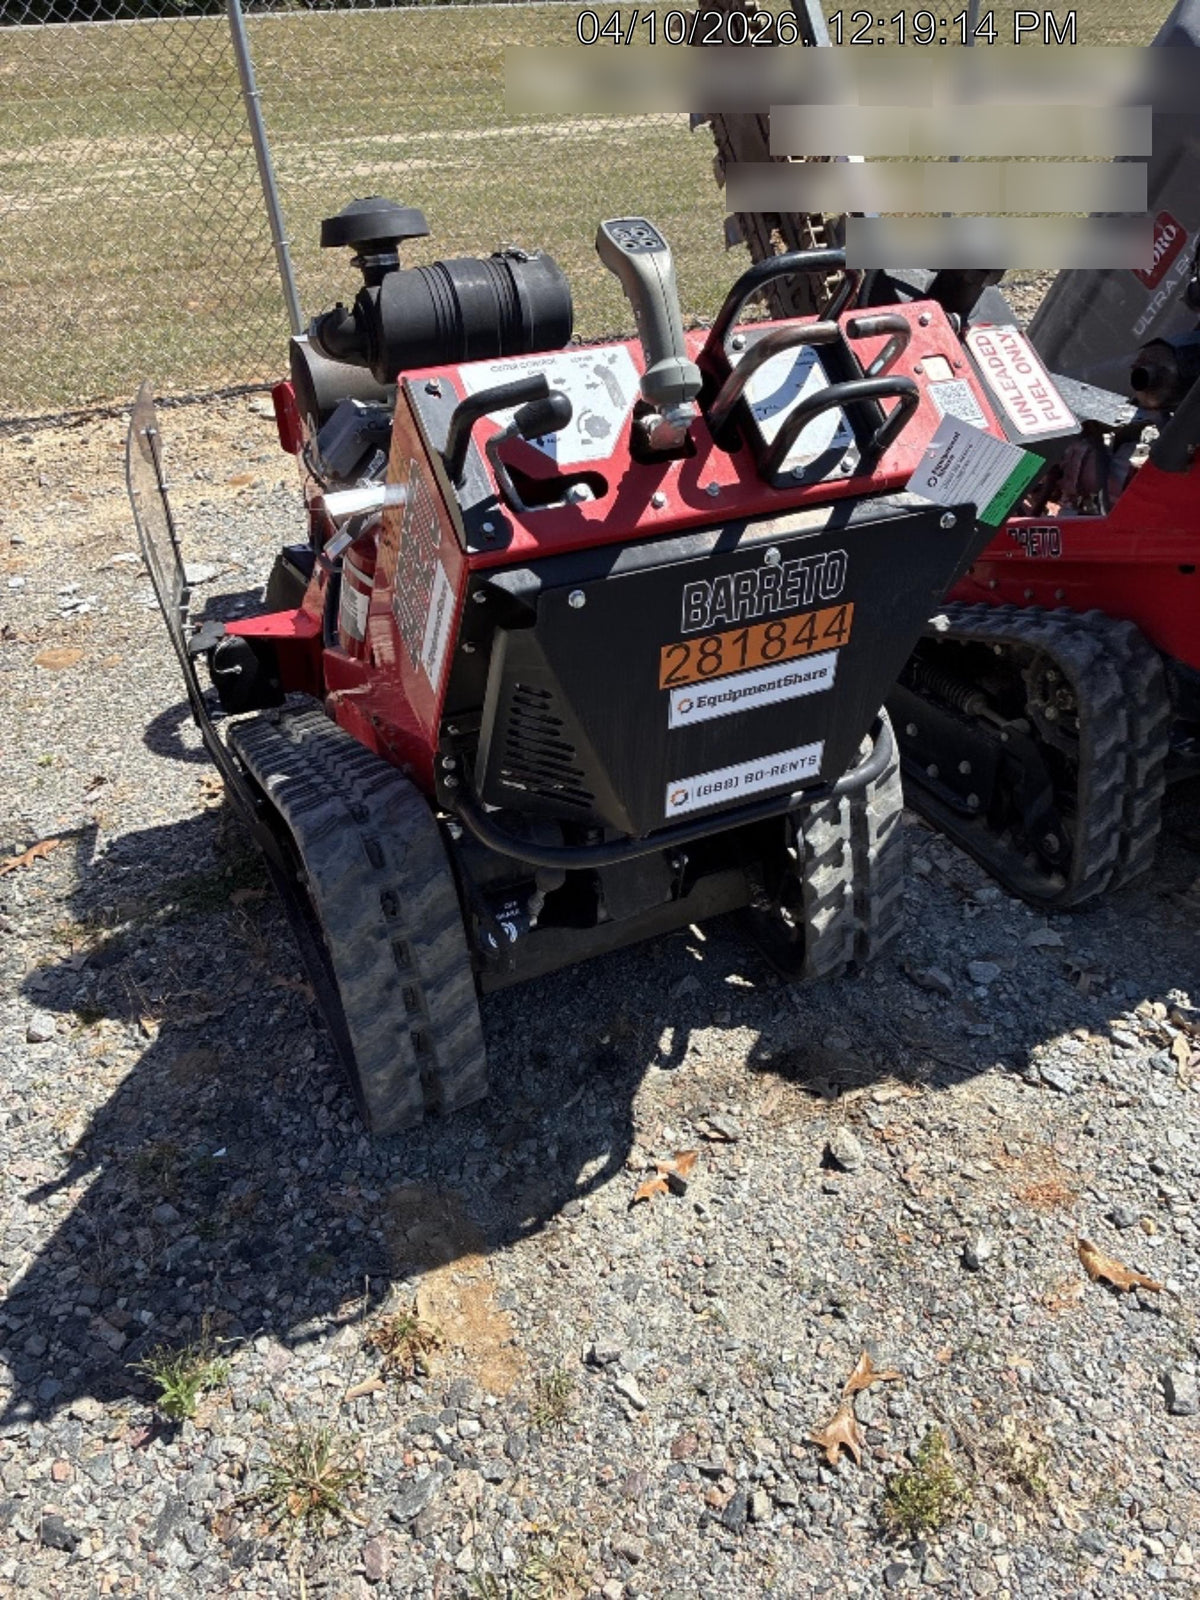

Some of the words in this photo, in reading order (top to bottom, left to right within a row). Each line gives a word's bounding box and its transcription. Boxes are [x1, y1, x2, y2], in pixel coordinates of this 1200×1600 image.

[1145, 224, 1178, 276] ORO
[1132, 279, 1178, 336] ULTRA
[998, 332, 1032, 375] ONLY
[975, 335, 1038, 426] UNLEADED
[1030, 381, 1062, 424] FUEL
[681, 549, 849, 634] BARRETO
[663, 605, 849, 686] 281844
[696, 666, 829, 710] EquipmentShare
[696, 777, 740, 798] (888)
